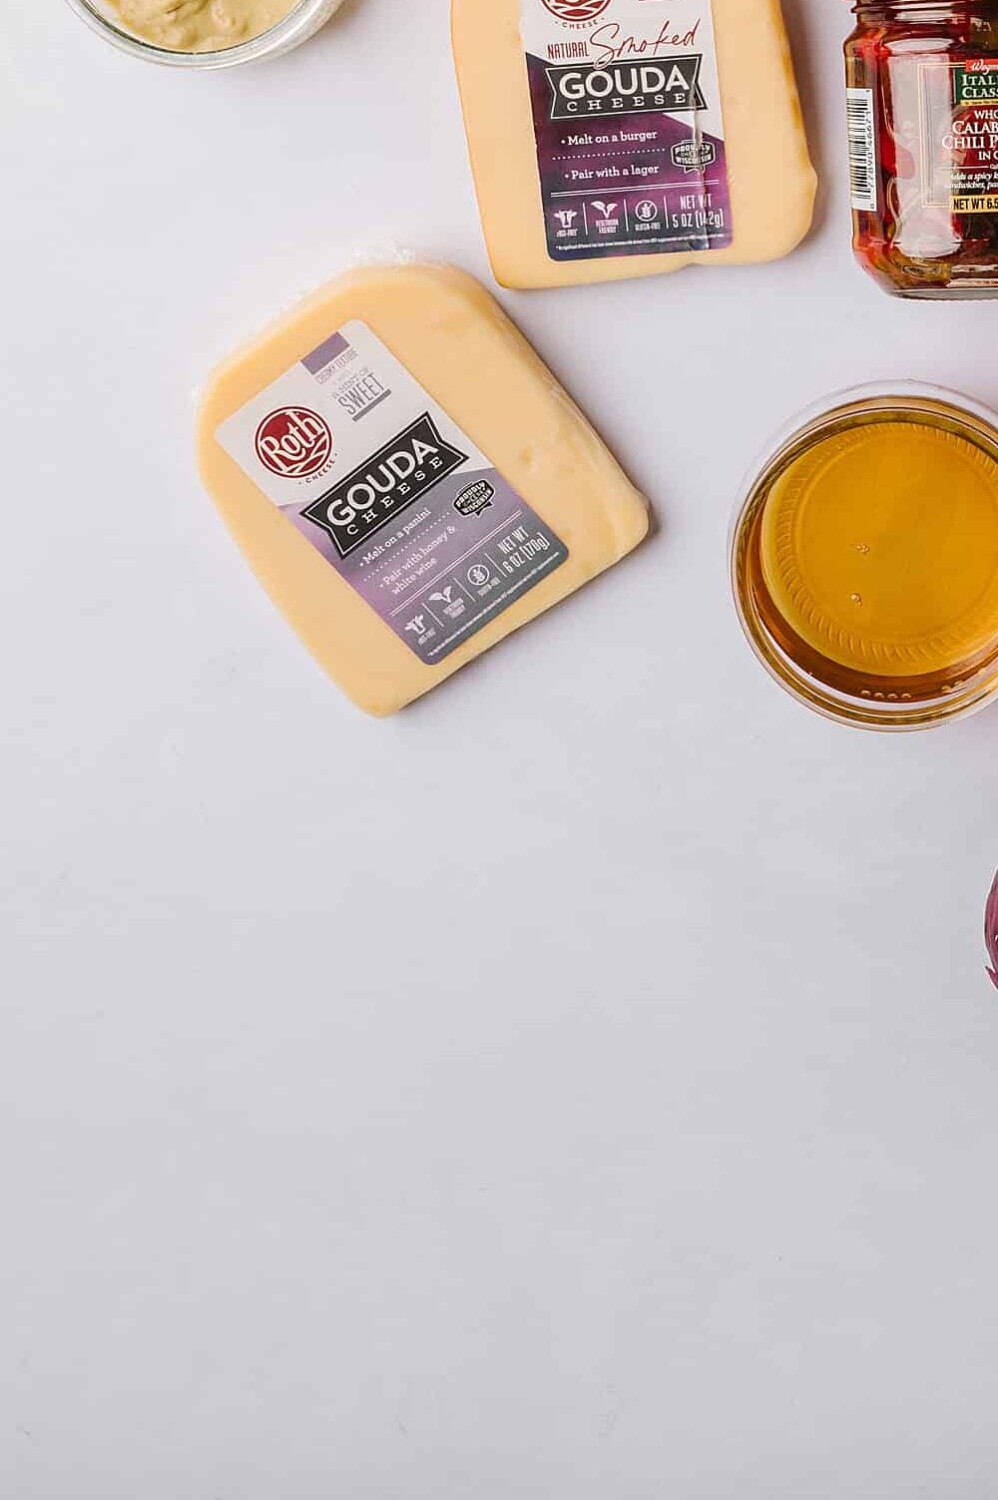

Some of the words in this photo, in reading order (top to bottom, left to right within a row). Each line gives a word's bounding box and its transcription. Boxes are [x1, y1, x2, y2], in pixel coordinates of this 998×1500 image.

[562, 21, 598, 30] CHEESE
[547, 41, 590, 60] NATURAL
[590, 18, 701, 70] Smoked
[559, 65, 690, 99] GOUDA
[566, 93, 687, 112] CHEESE
[567, 133, 593, 146] Melt
[595, 135, 610, 143] on
[611, 134, 618, 142] a
[620, 131, 658, 144] burger
[942, 135, 985, 150] CHILI
[978, 151, 991, 160] IN
[571, 169, 593, 180] Pair
[595, 167, 621, 179] with
[622, 168, 629, 176] a
[631, 165, 660, 177] lager
[680, 195, 697, 210] NET
[953, 199, 970, 210] NET
[971, 198, 985, 209] WT
[987, 198, 998, 209] 6.5
[672, 214, 680, 227] 5
[682, 213, 694, 227] OZ
[337, 372, 385, 415] SWEET
[260, 411, 326, 474] Roth
[306, 459, 336, 484] CHEESE
[327, 438, 439, 526] GOUDA
[346, 456, 443, 535] CHEESE
[362, 544, 385, 565] Melt
[384, 536, 398, 548] on
[398, 530, 404, 539] a
[404, 507, 432, 535] panini
[497, 536, 516, 554] NET
[512, 526, 530, 543] WT
[382, 567, 403, 585] Pair
[401, 553, 423, 572] with
[421, 532, 448, 556] honey
[446, 525, 456, 535] &
[502, 560, 513, 574] 6
[512, 550, 526, 568] OZ
[391, 573, 417, 595] white
[415, 556, 438, 578] wine
